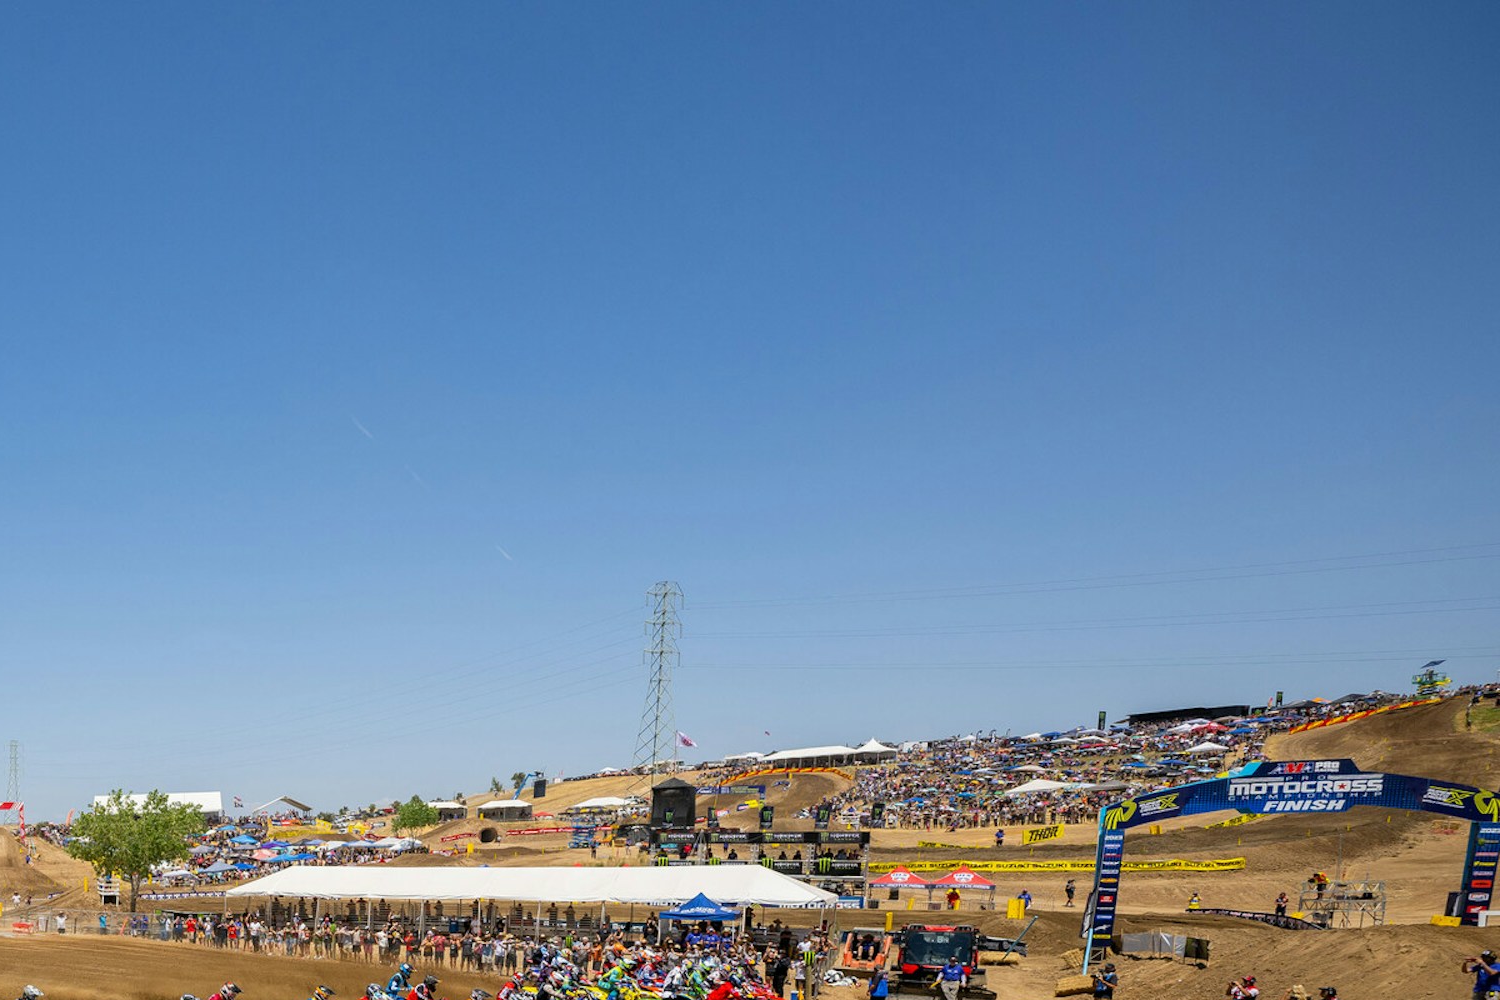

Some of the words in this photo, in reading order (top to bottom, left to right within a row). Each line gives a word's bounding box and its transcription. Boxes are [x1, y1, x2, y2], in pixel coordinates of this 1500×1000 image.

[1315, 761, 1340, 769] PRO
[1228, 779, 1384, 796] MOTOCROSS
[1228, 791, 1383, 801] CHAMPIONSHIP
[1263, 799, 1347, 812] FINISH
[1028, 826, 1059, 841] THOR
